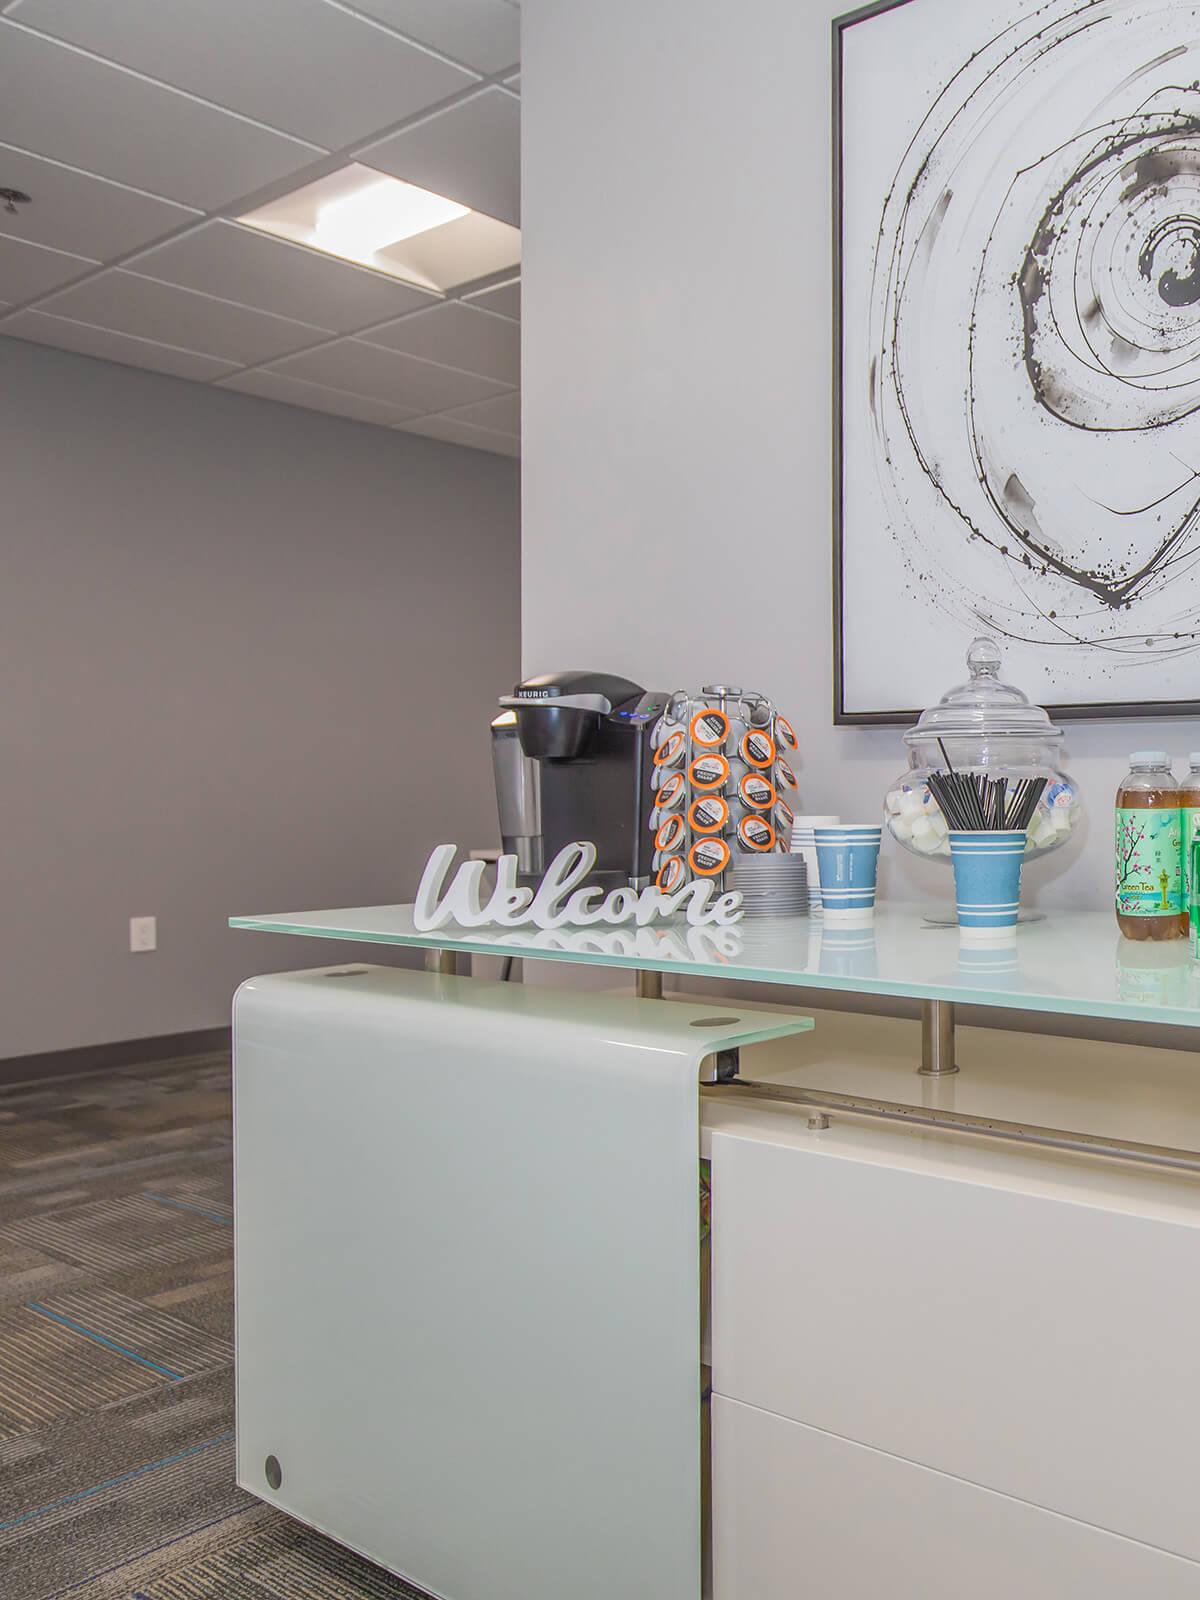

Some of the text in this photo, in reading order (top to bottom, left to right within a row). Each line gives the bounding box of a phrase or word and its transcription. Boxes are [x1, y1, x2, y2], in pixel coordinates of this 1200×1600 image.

[518, 690, 549, 698] KEURIG
[413, 841, 744, 932] Welcome
[1140, 882, 1155, 892] Tea
